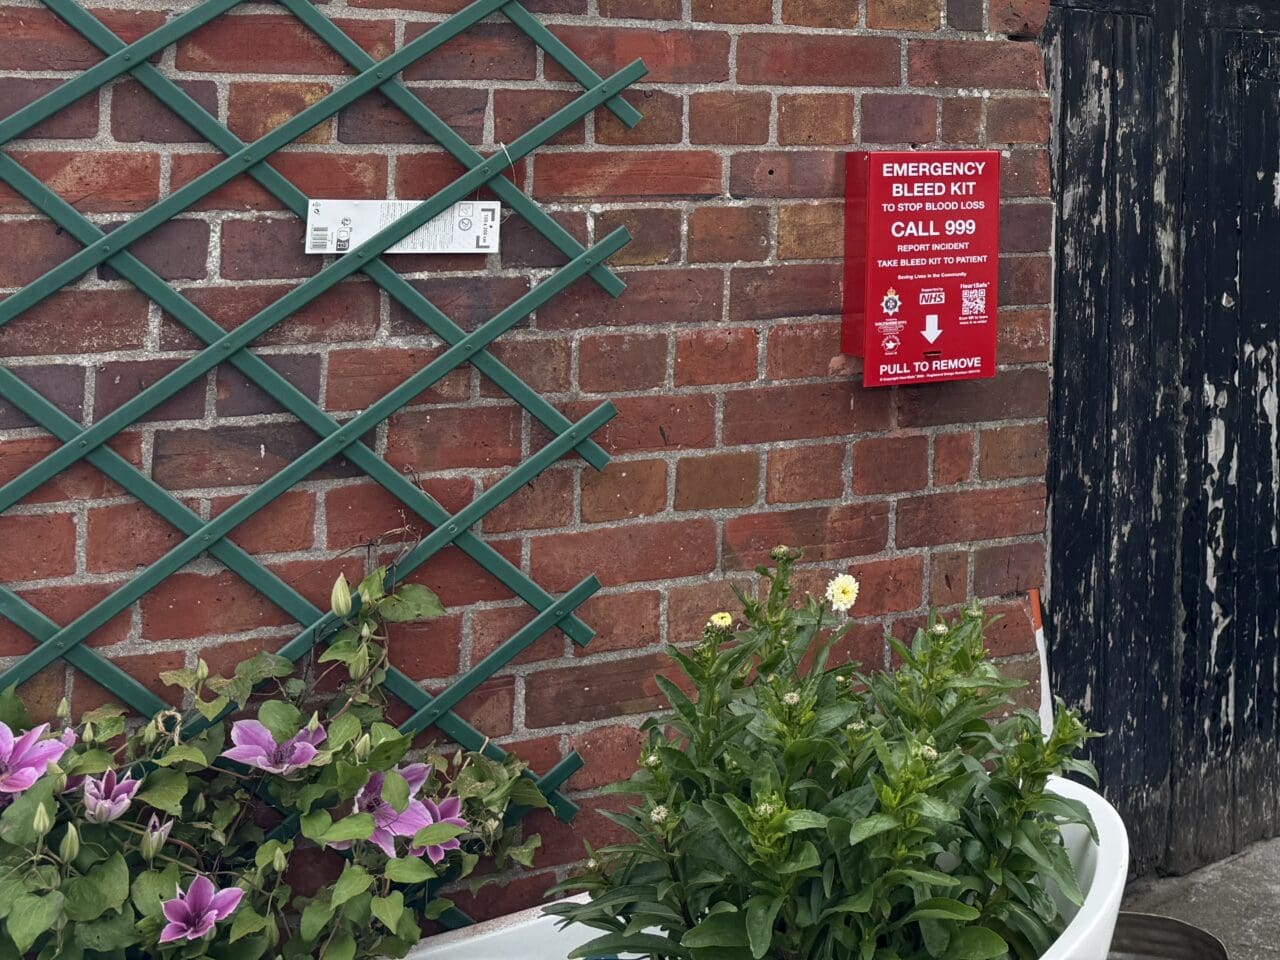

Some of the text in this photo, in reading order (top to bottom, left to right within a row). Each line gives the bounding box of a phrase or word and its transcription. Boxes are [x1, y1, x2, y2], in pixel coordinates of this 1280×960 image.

[882, 161, 986, 177] EMERGENCY
[892, 181, 977, 197] BLEED KIT
[882, 200, 985, 212] TO STOP BLOOD LOSS
[891, 219, 976, 238] CALL 999
[897, 242, 970, 252] REPORT INCIDENT
[877, 254, 988, 268] TAKE BLEED KIT TO PATIENT
[921, 293, 944, 303] NHS
[880, 362, 910, 375] PULL
[913, 361, 929, 372] TO
[932, 356, 982, 371] REMOVE
